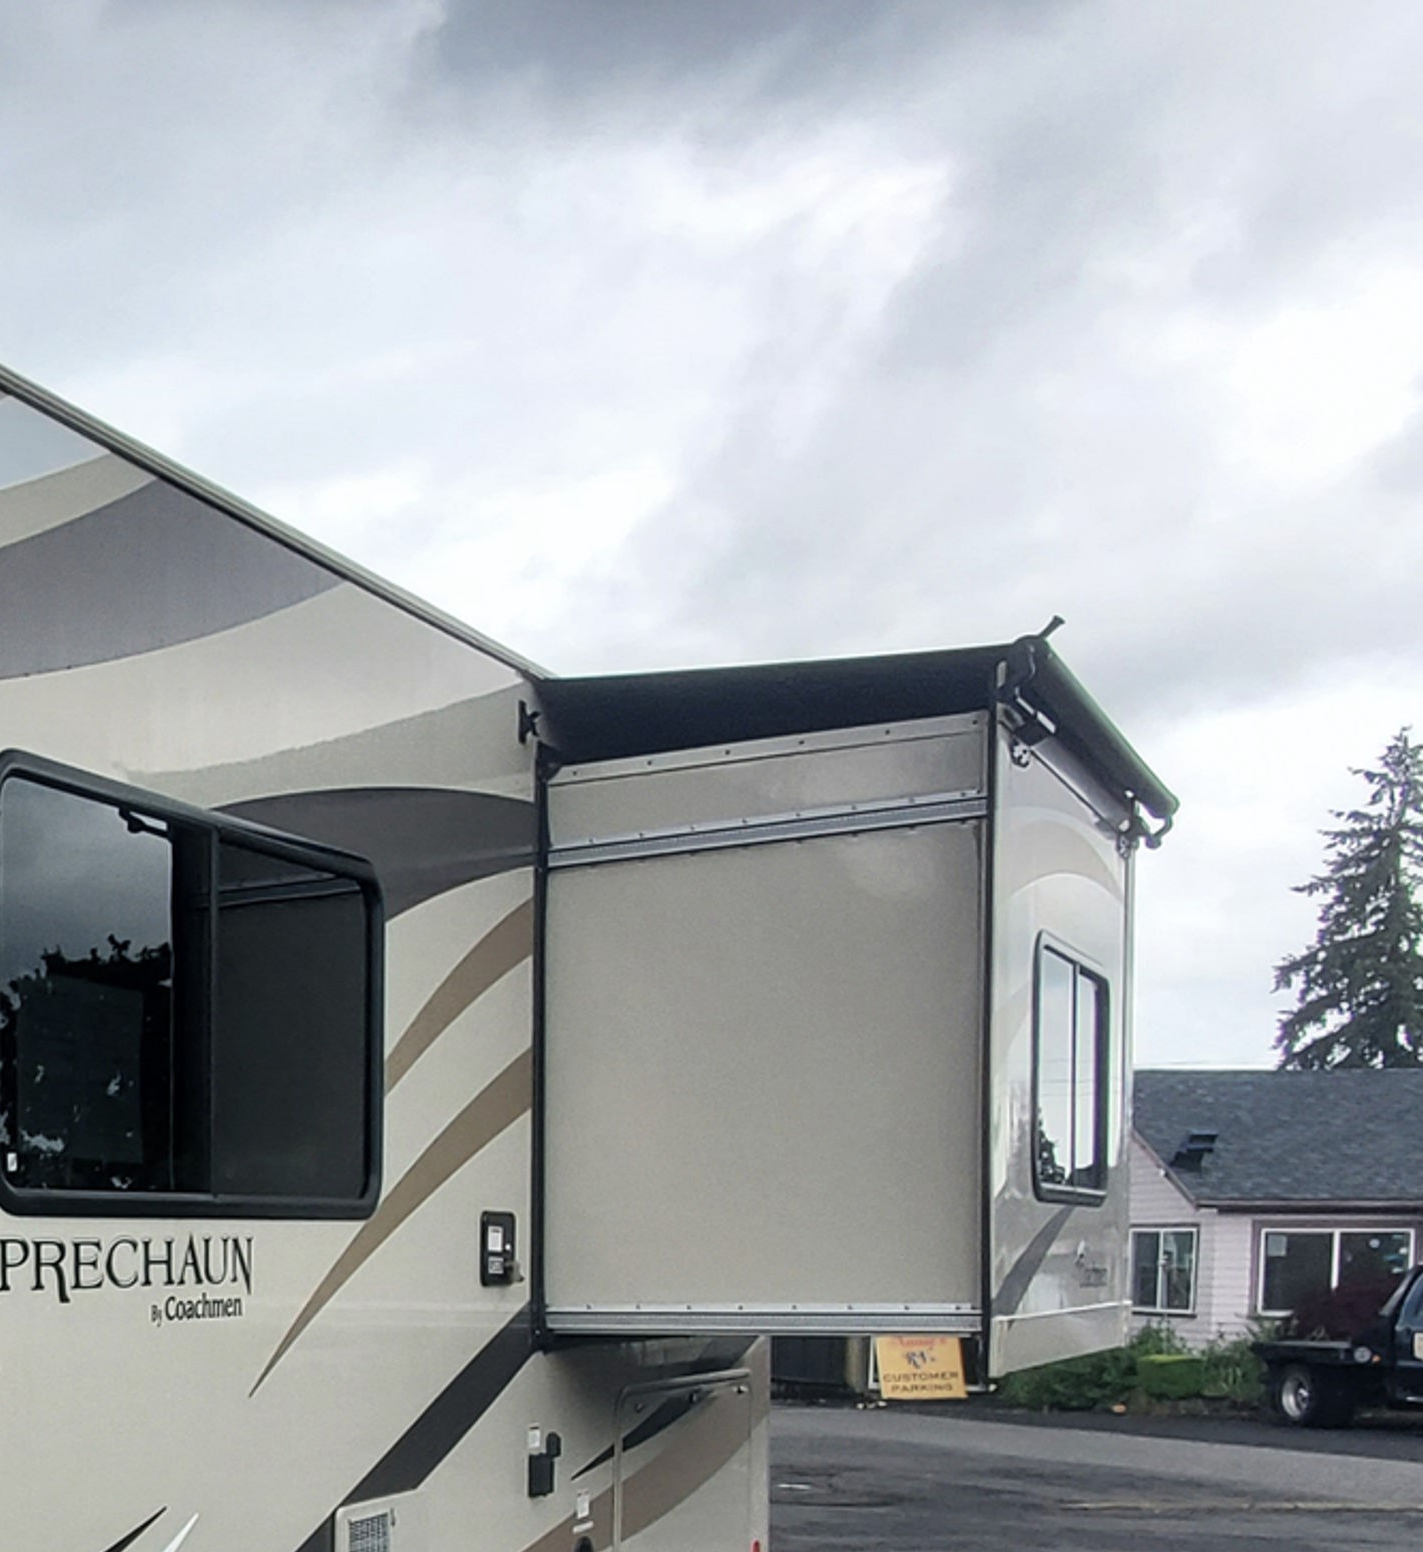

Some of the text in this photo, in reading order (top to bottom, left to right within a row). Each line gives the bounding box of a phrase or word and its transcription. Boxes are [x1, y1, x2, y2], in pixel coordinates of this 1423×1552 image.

[164, 1295, 243, 1322] Coachmen
[883, 1371, 959, 1383] CUSTOMER
[890, 1384, 954, 1394] PARKING
